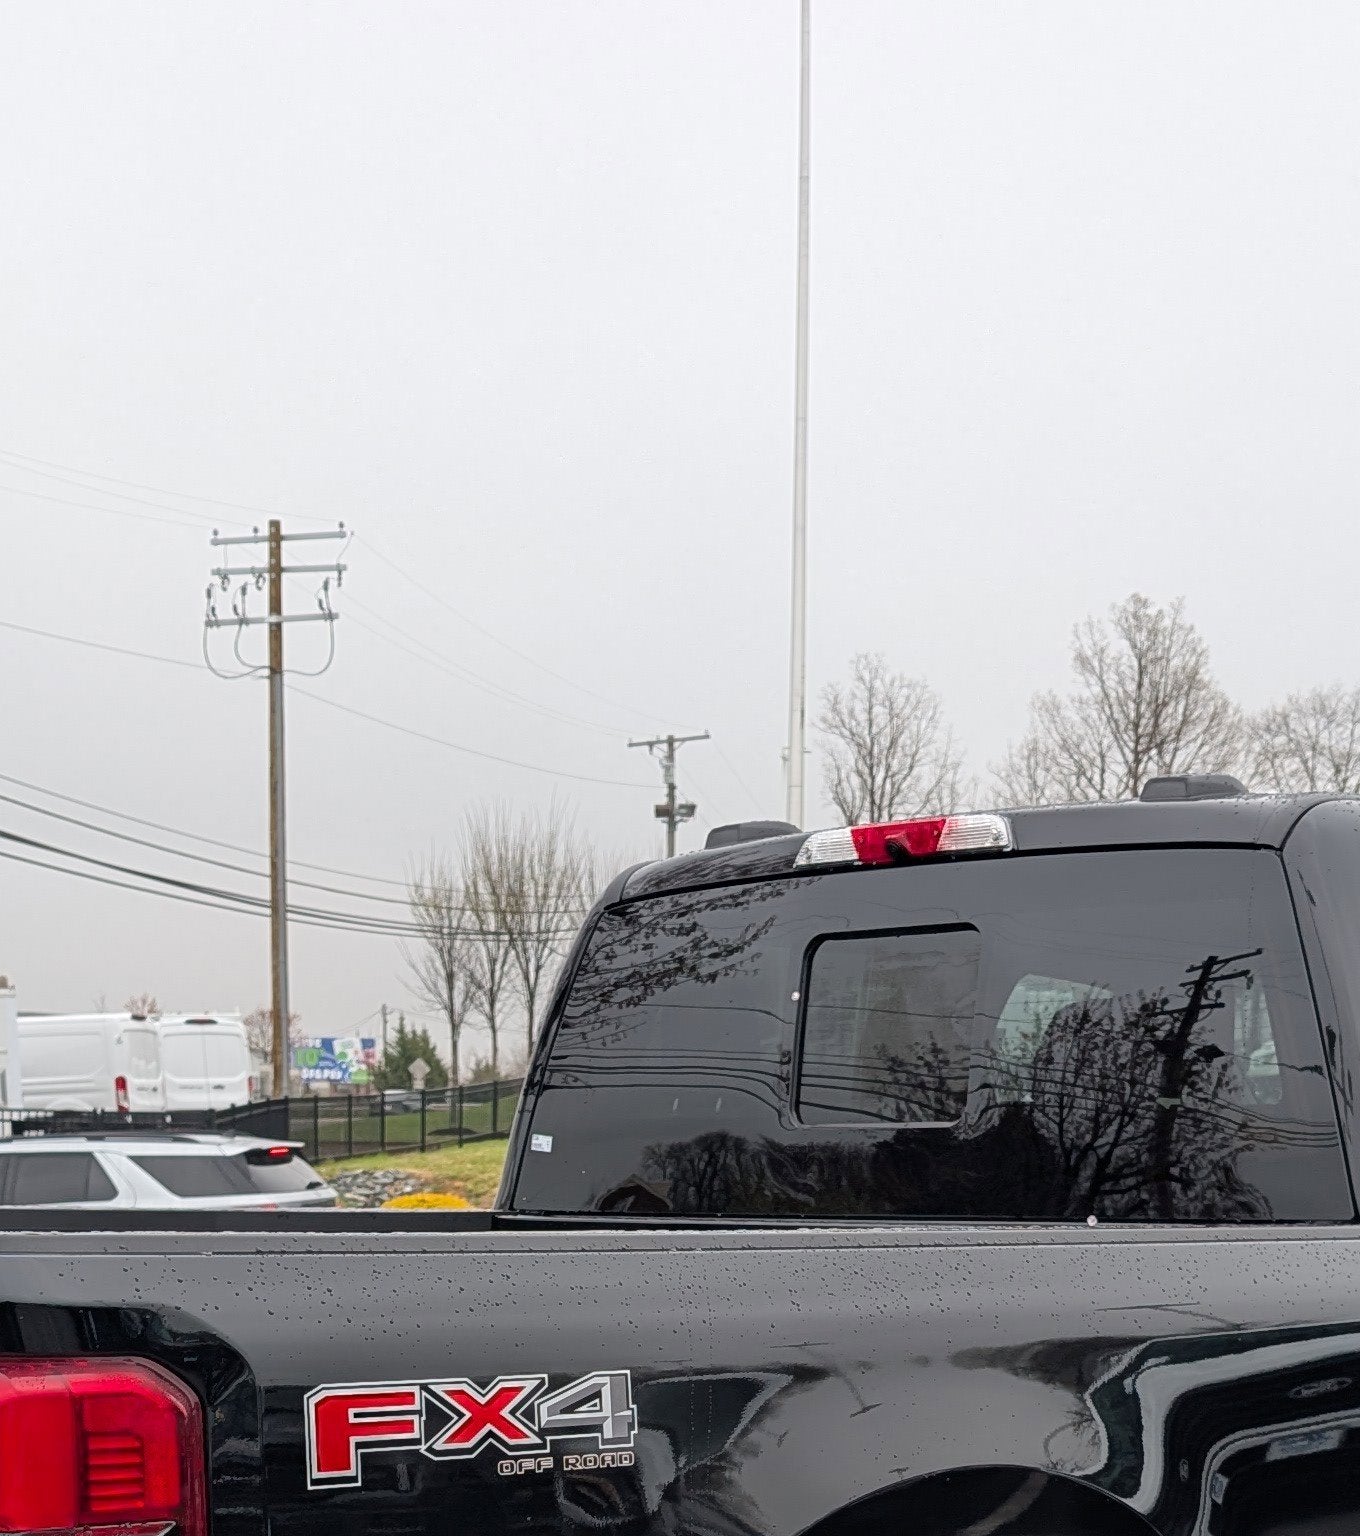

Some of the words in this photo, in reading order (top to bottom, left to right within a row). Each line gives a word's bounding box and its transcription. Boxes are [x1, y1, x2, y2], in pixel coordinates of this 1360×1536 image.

[304, 1370, 638, 1490] FX4
[498, 1456, 553, 1475] OFF
[563, 1452, 635, 1471] ROAD
